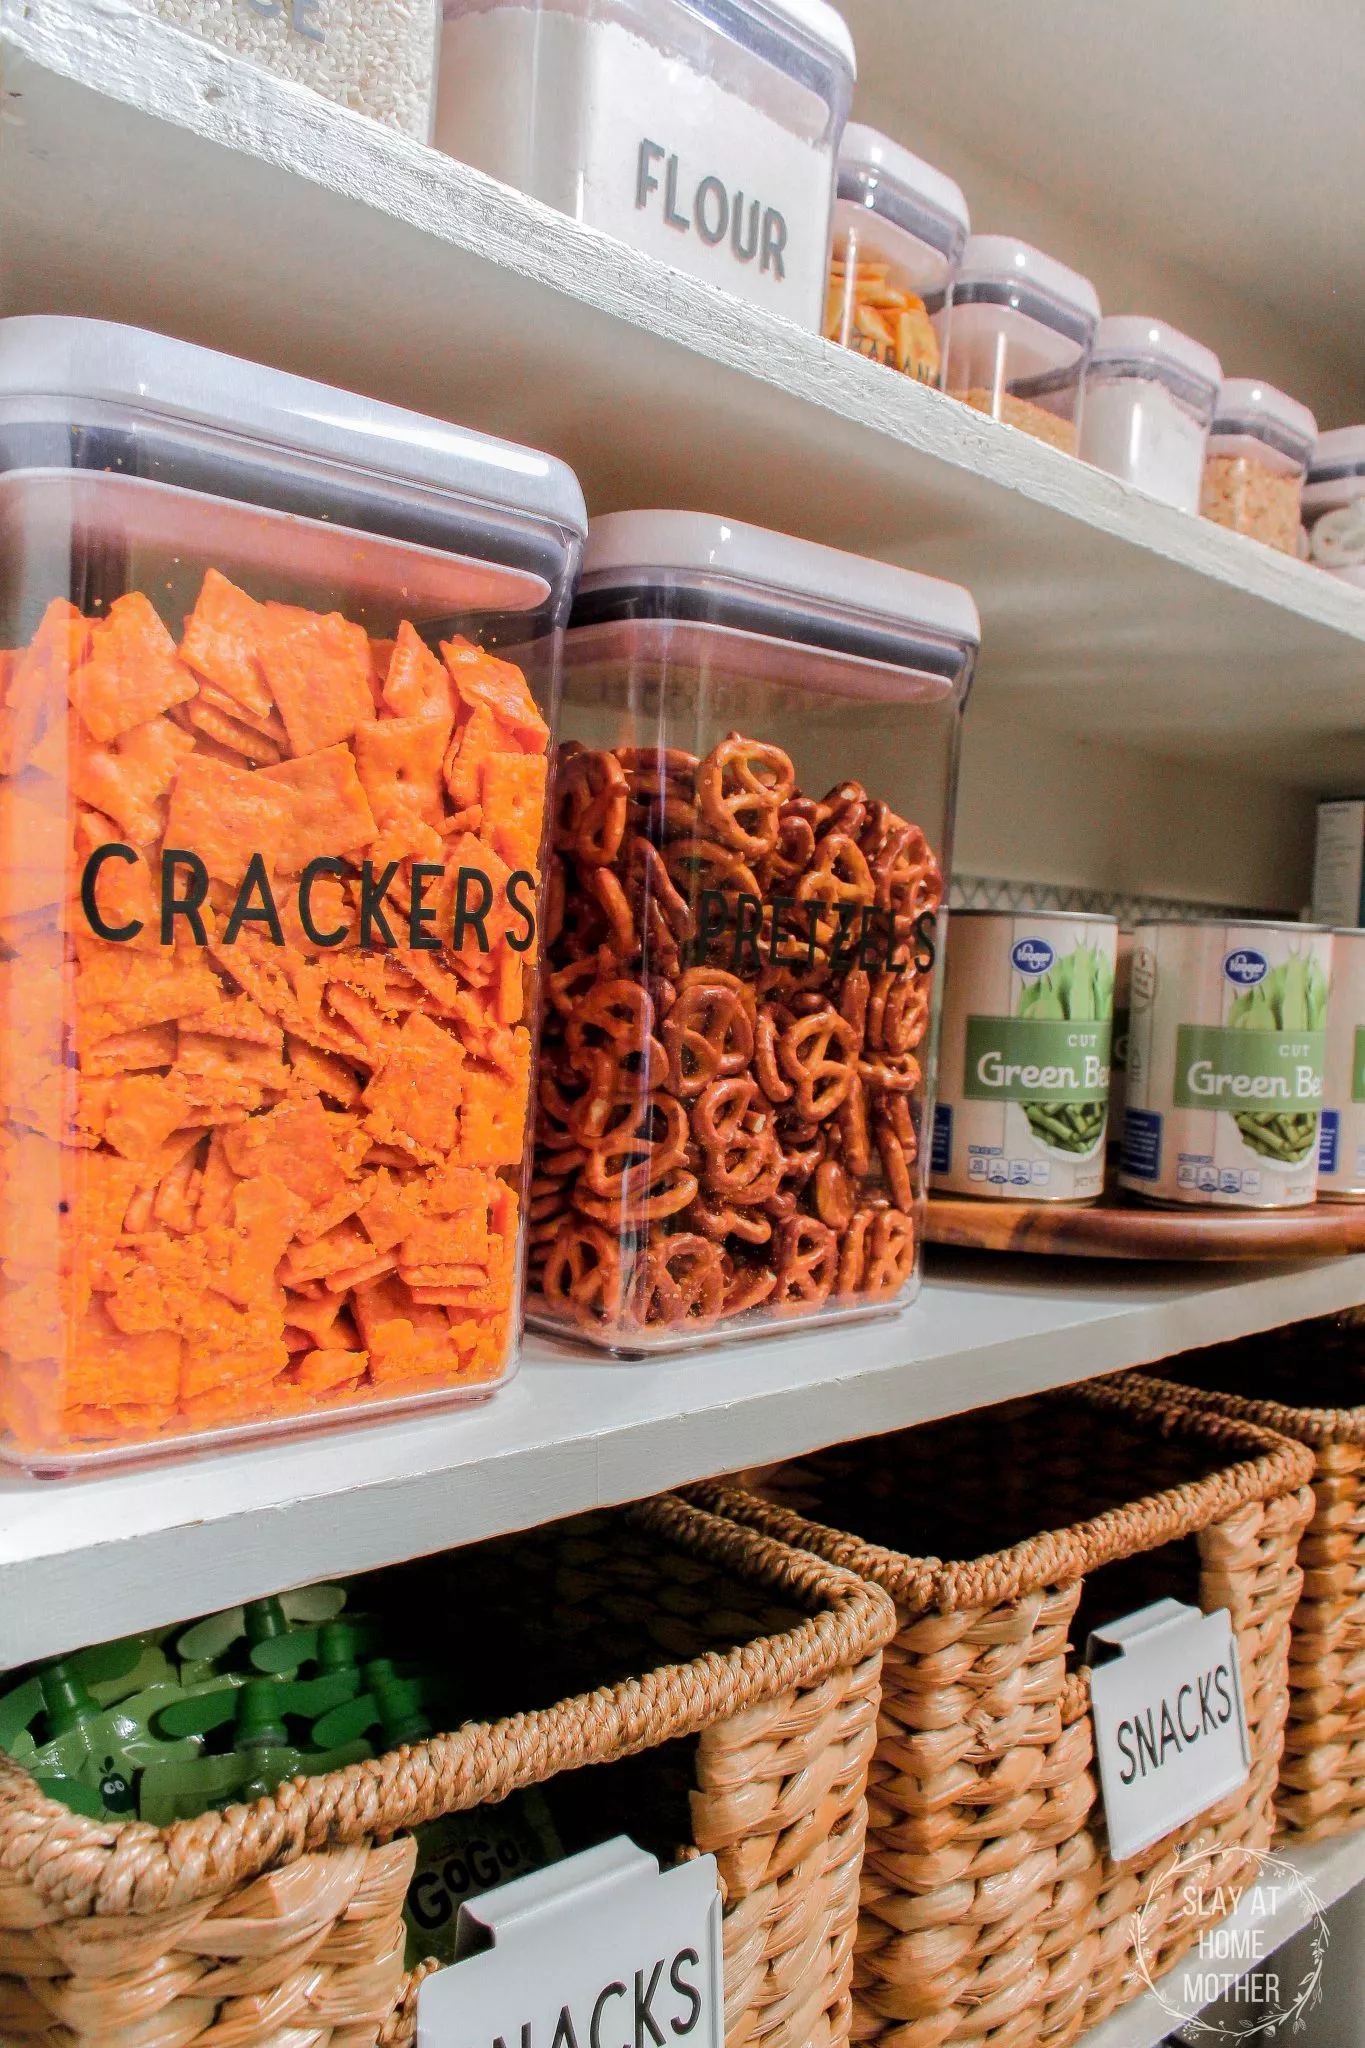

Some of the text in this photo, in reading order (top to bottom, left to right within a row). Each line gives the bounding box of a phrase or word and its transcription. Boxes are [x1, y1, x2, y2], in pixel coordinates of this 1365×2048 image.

[635, 138, 788, 281] FLOUR
[81, 843, 537, 953] CRACKERS
[696, 888, 937, 973] PRETZELS
[1016, 943, 1051, 969] Kroger
[1229, 954, 1265, 980] Kroger
[1067, 1034, 1097, 1048] CUT
[1279, 1044, 1310, 1057] CUT
[977, 1051, 1080, 1089] Green
[1187, 1060, 1291, 1098] Green
[1116, 1663, 1233, 1785] SNACKS
